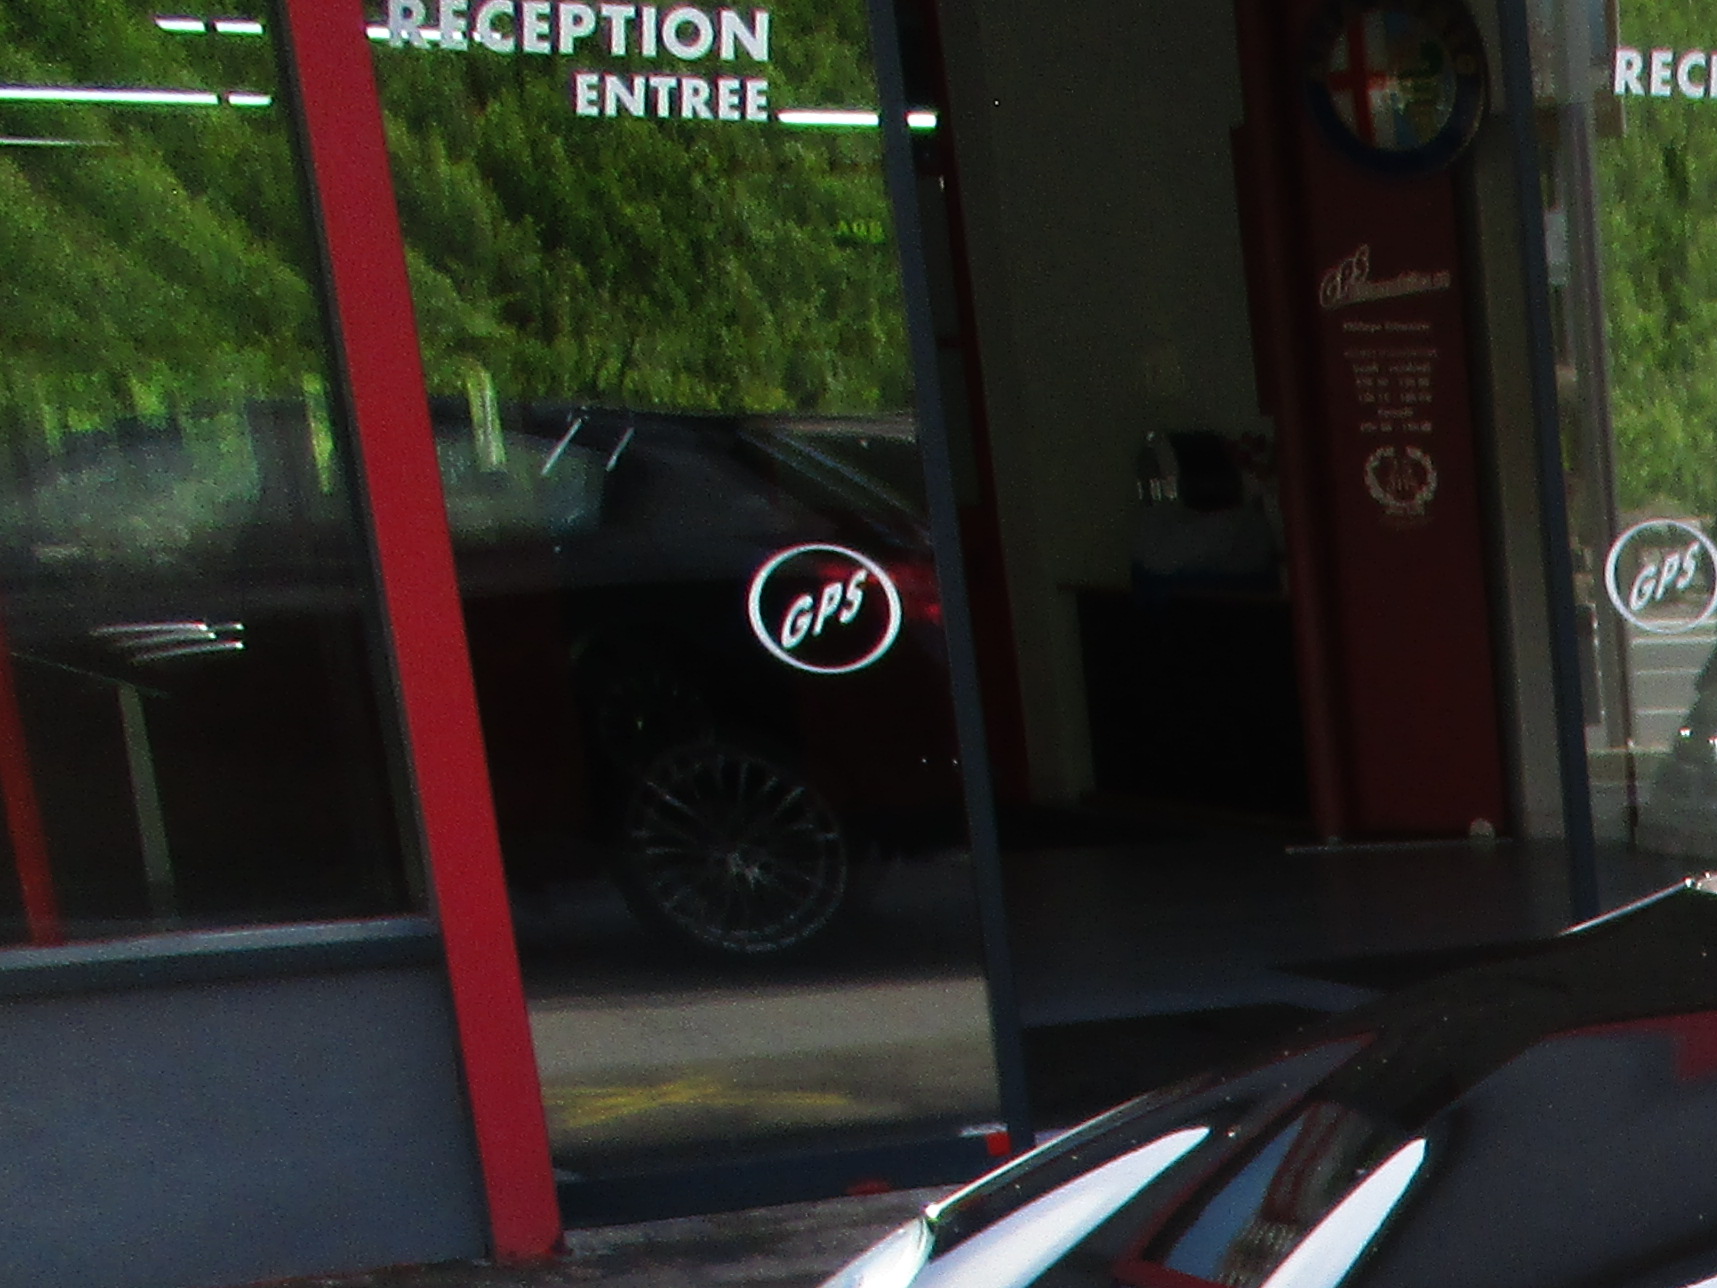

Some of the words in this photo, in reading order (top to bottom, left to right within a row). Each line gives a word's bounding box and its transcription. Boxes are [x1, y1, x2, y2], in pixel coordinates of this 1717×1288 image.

[387, 0, 770, 62] RECEPTION
[574, 72, 769, 121] ENTREE
[781, 568, 868, 649] GPS
[1629, 540, 1700, 611] GPS
